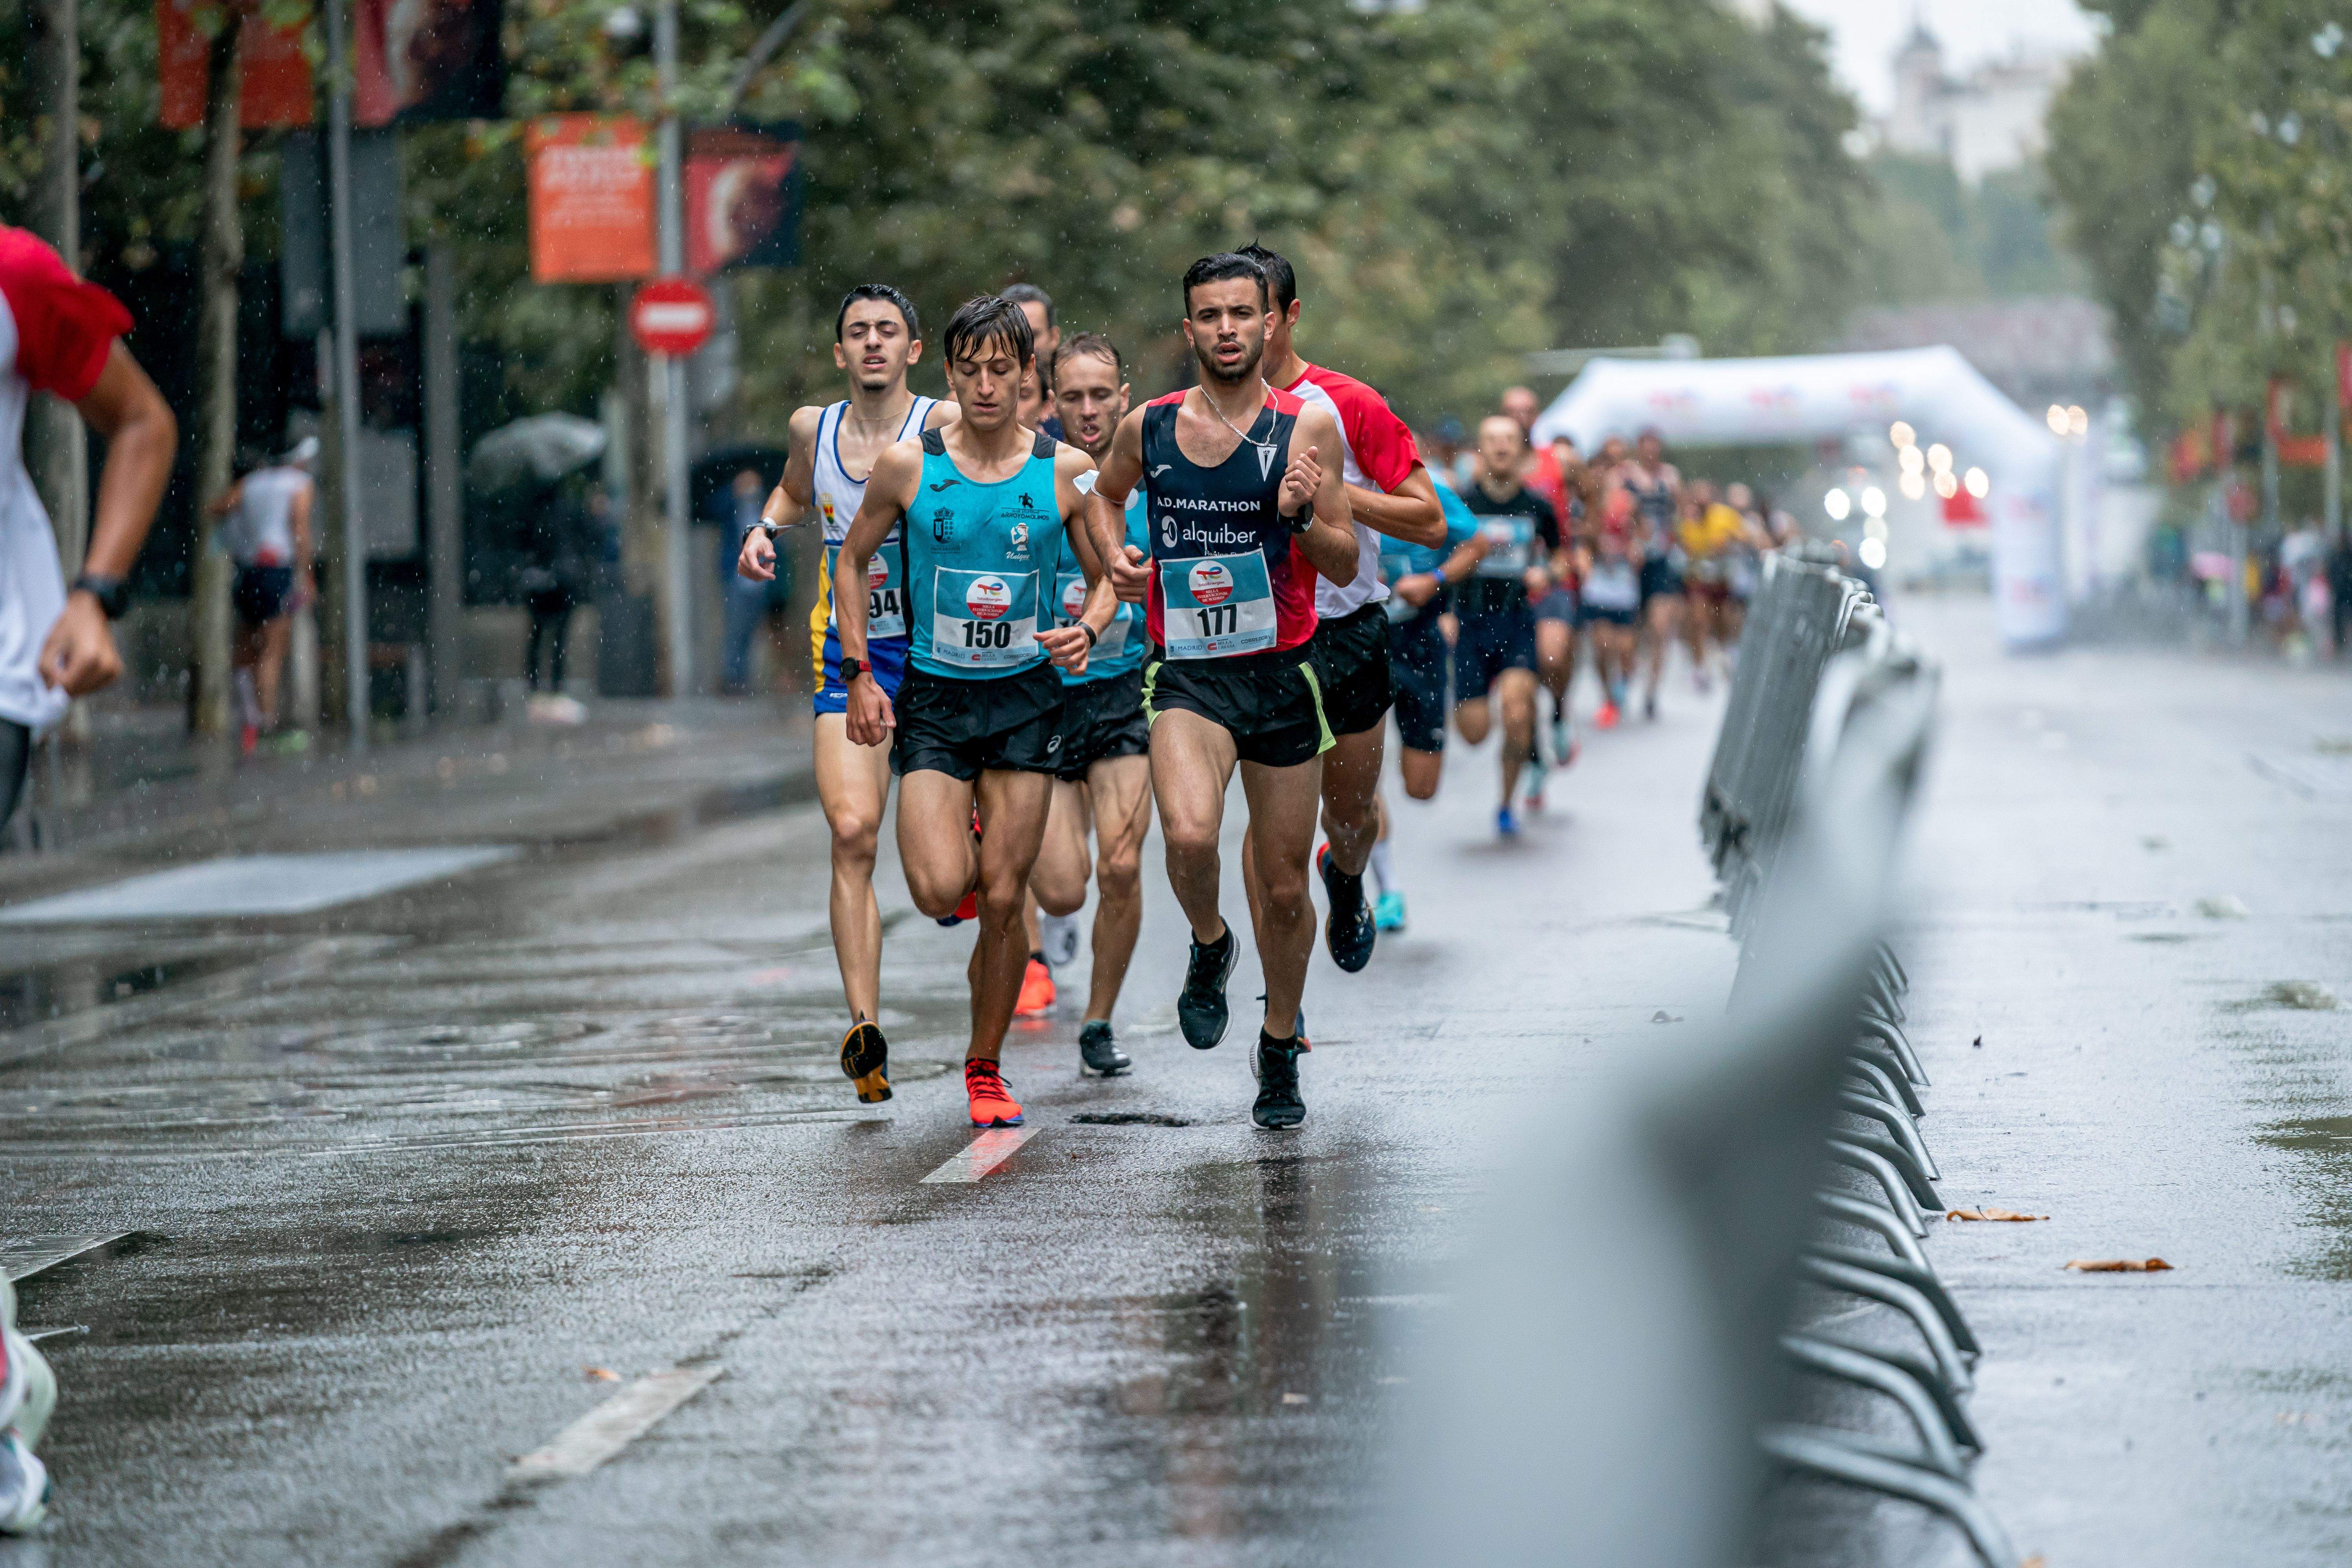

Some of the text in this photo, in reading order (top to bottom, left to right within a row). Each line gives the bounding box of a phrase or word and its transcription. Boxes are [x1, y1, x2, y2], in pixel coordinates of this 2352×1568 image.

[1001, 512, 1049, 521] ARROYOMOLINOS
[1183, 521, 1256, 550] alquiber
[1006, 551, 1030, 562] Unique
[1197, 603, 1237, 637] 177
[962, 621, 1011, 648] 150
[944, 649, 965, 659] MADRID
